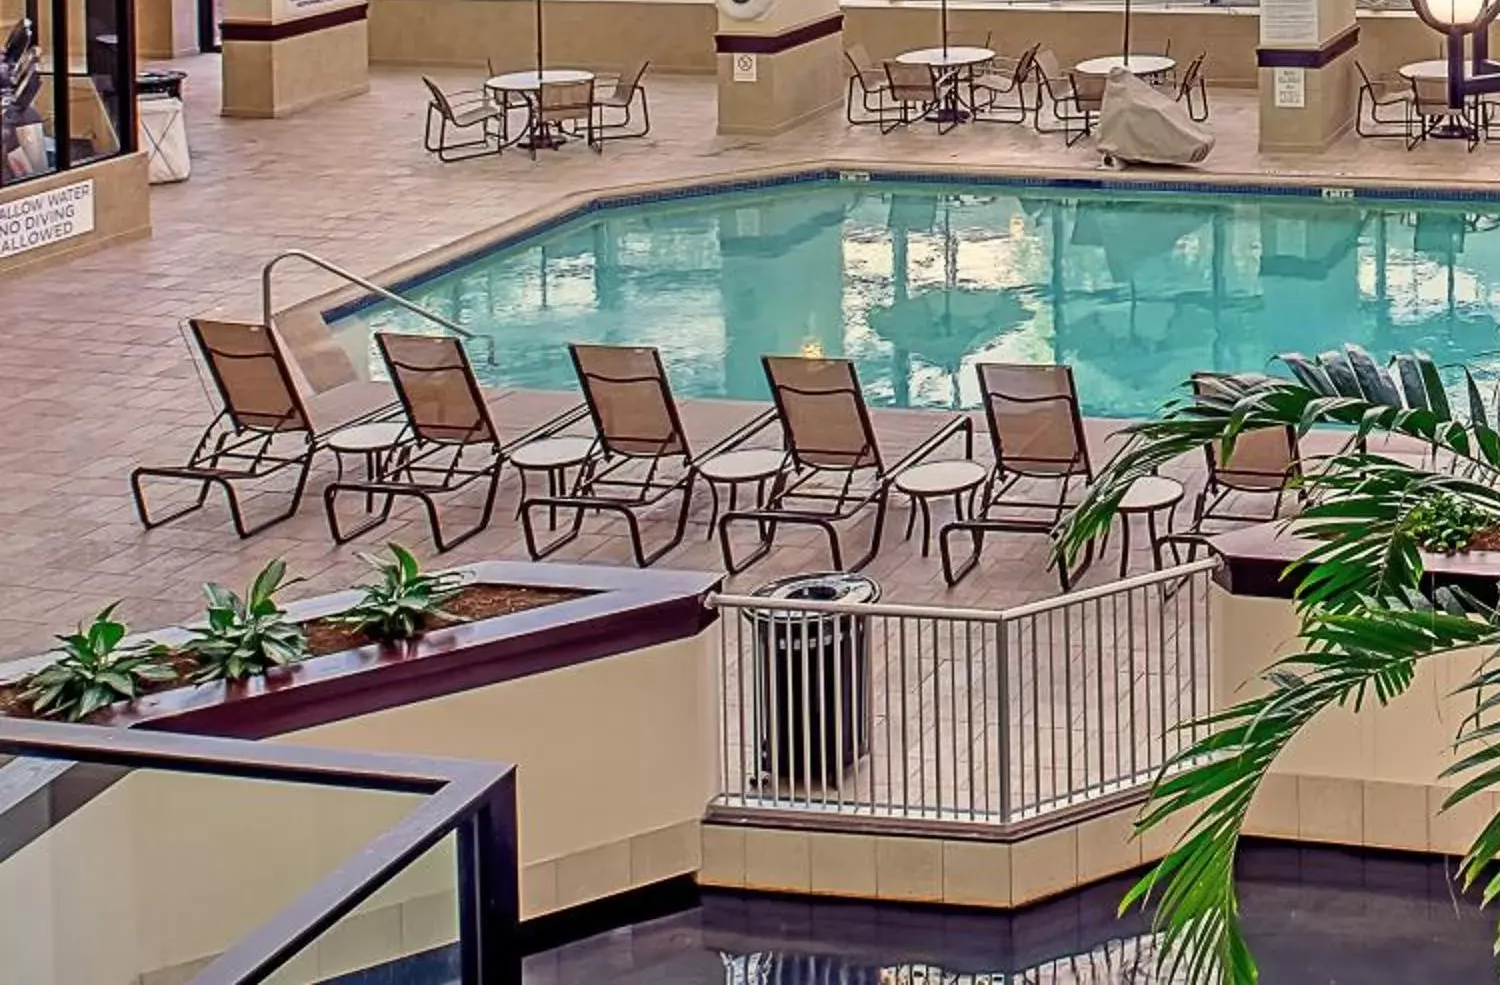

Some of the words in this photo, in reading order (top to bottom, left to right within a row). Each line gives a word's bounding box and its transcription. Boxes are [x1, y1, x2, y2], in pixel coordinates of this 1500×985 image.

[48, 184, 89, 208] WATER
[25, 204, 75, 230] DIVING
[1, 221, 73, 252] ALLOWED
